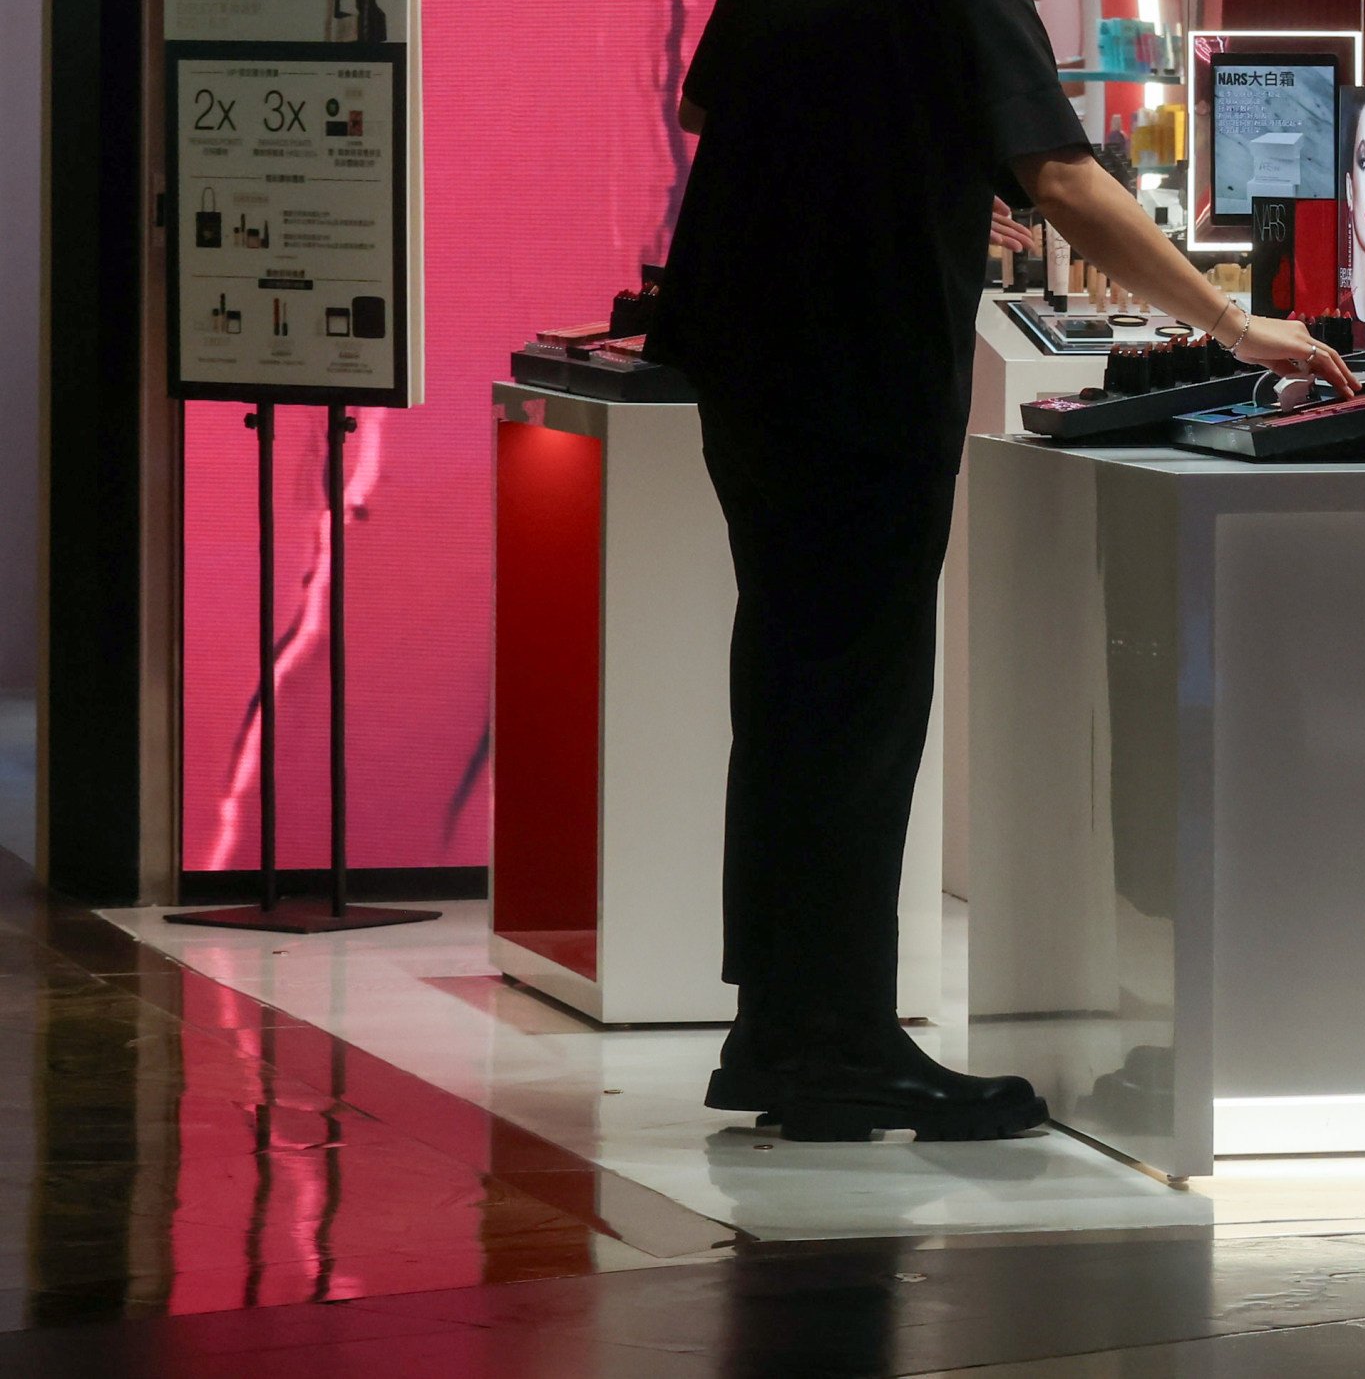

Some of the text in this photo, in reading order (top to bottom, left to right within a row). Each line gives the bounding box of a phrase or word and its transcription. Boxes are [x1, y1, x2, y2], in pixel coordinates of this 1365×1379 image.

[1218, 70, 1295, 87] NARS大白霜
[194, 88, 307, 132] 2x 3x
[1252, 203, 1287, 243] NARS
